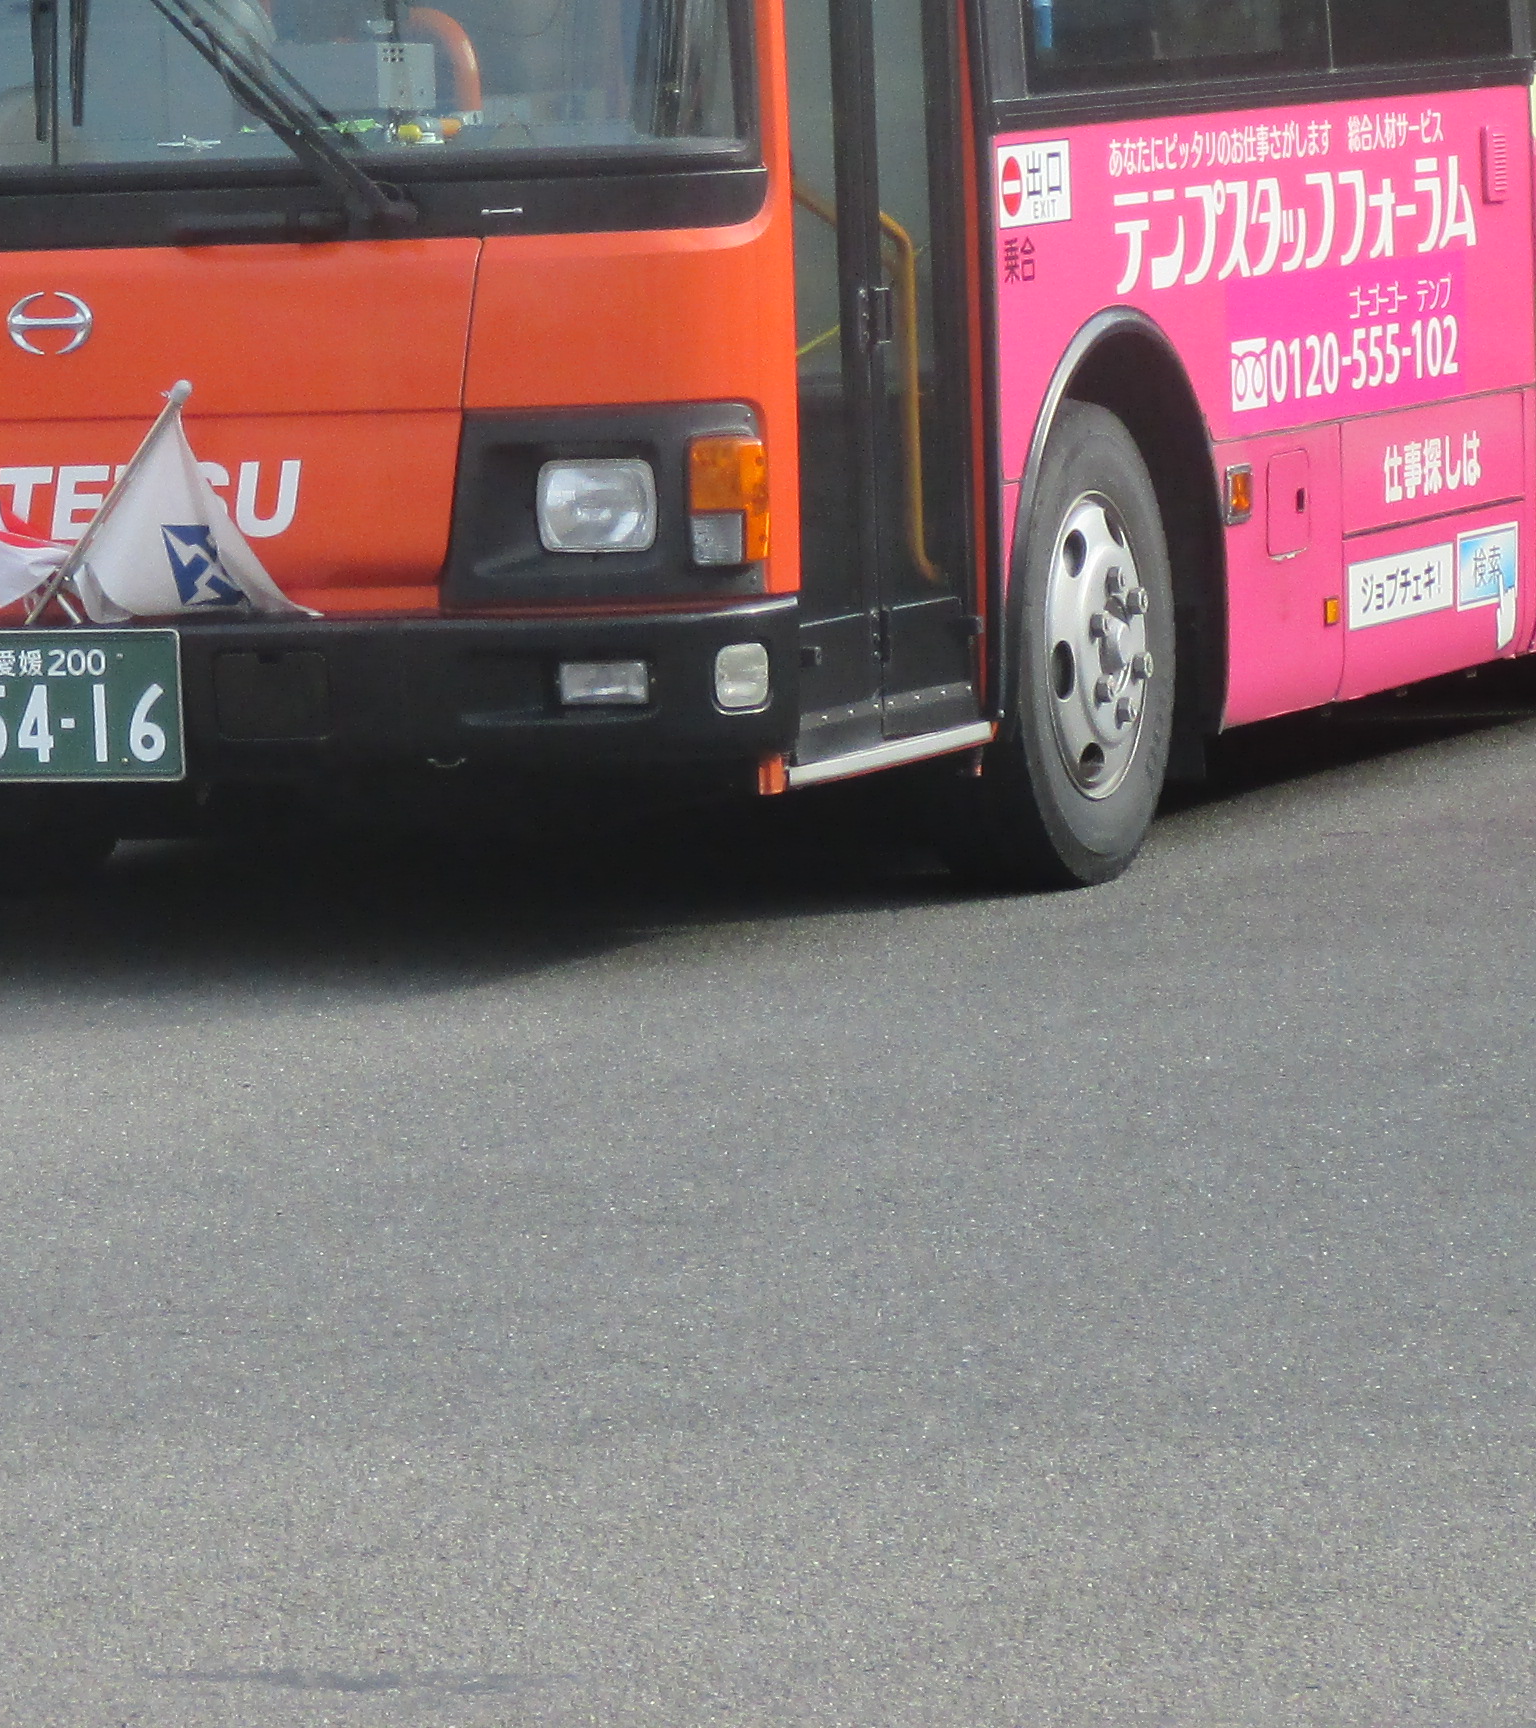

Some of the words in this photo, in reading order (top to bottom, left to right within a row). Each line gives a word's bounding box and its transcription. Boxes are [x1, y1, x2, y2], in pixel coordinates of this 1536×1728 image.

[1108, 120, 1332, 178] あなたにピッタリのお仕事さがします
[1347, 108, 1445, 154] 総合人材サービス
[1026, 150, 1063, 200] 出口
[1032, 199, 1057, 220] EXIT
[1113, 154, 1478, 296] テンプスタッフフォーラム
[1004, 235, 1036, 285] 乗合
[1349, 281, 1408, 319] ゴーゴーゴー
[1417, 272, 1453, 313] テンプ
[1270, 314, 1460, 404] 0120-555-102
[1383, 429, 1482, 504] 仕事探しは
[1472, 544, 1503, 589] 検索
